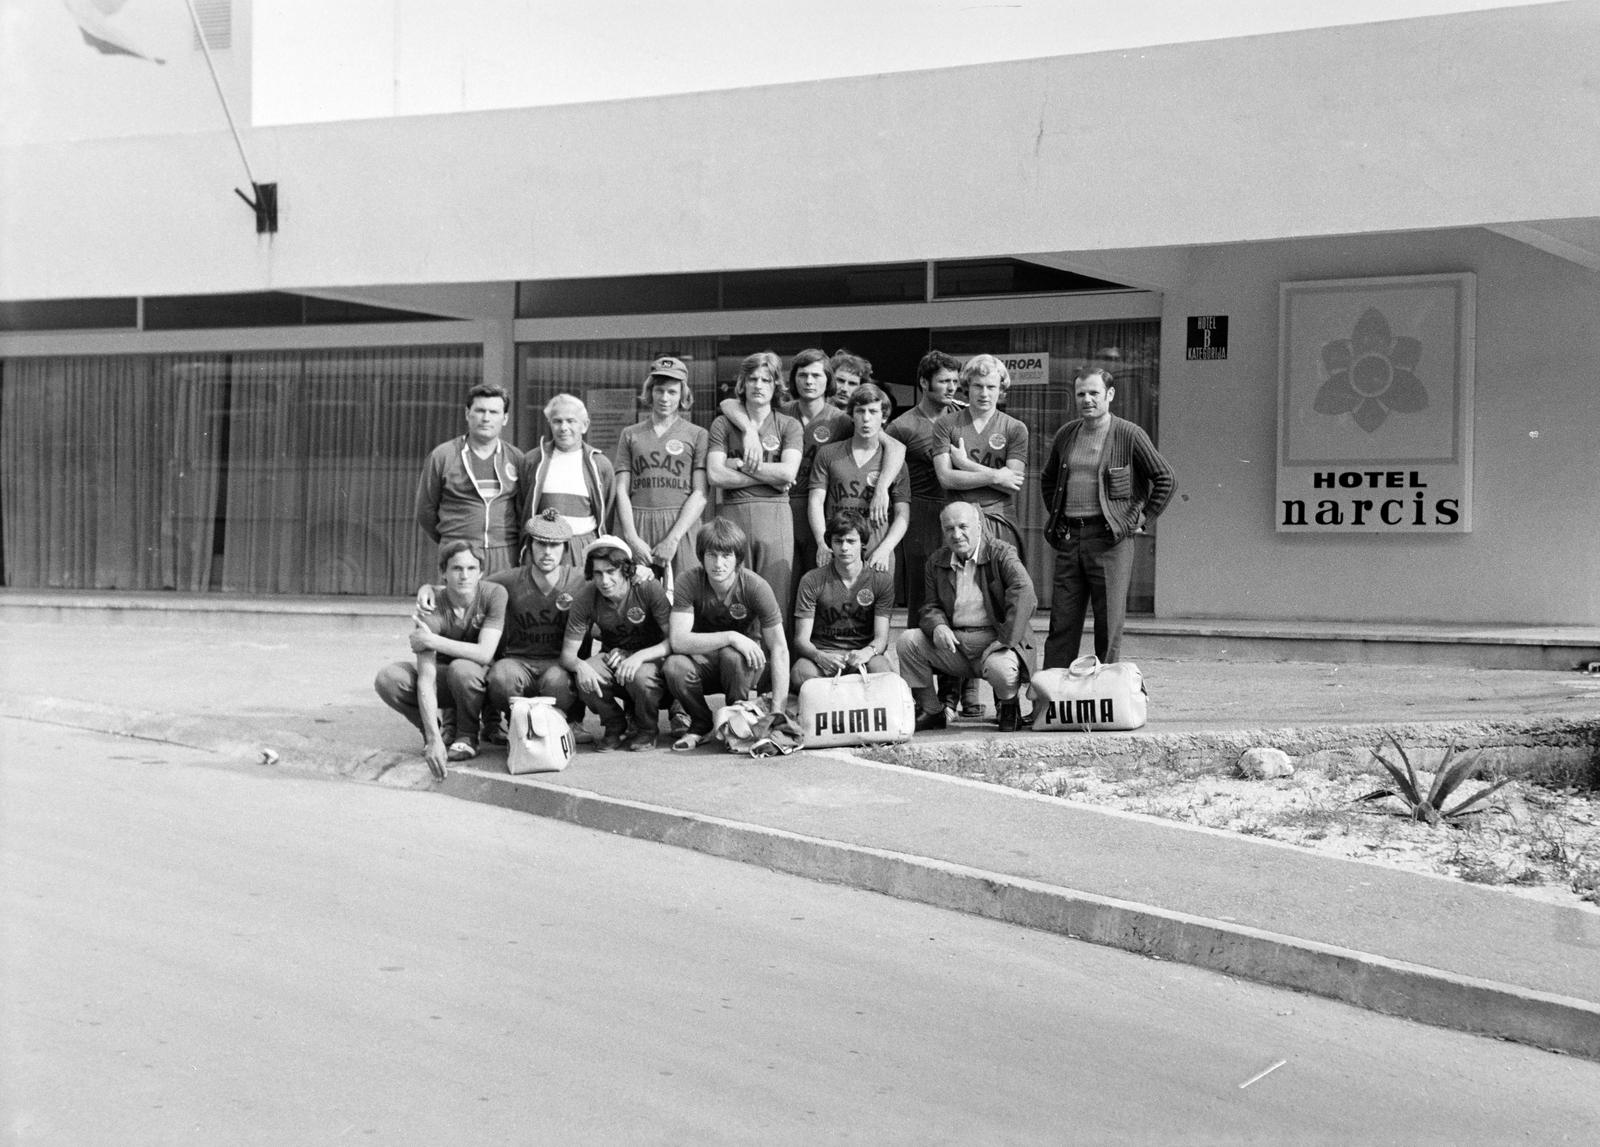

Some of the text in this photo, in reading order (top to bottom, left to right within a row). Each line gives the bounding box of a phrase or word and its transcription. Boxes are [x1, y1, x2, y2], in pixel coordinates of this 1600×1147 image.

[1197, 316, 1216, 330] HOTEL
[1204, 329, 1211, 347] B
[631, 451, 685, 477] VASAS
[828, 480, 875, 505] VASA
[1313, 471, 1428, 489] HOTEL
[1282, 491, 1460, 526] narcis
[815, 707, 887, 737] PUMA
[1045, 698, 1114, 725] PUMA
